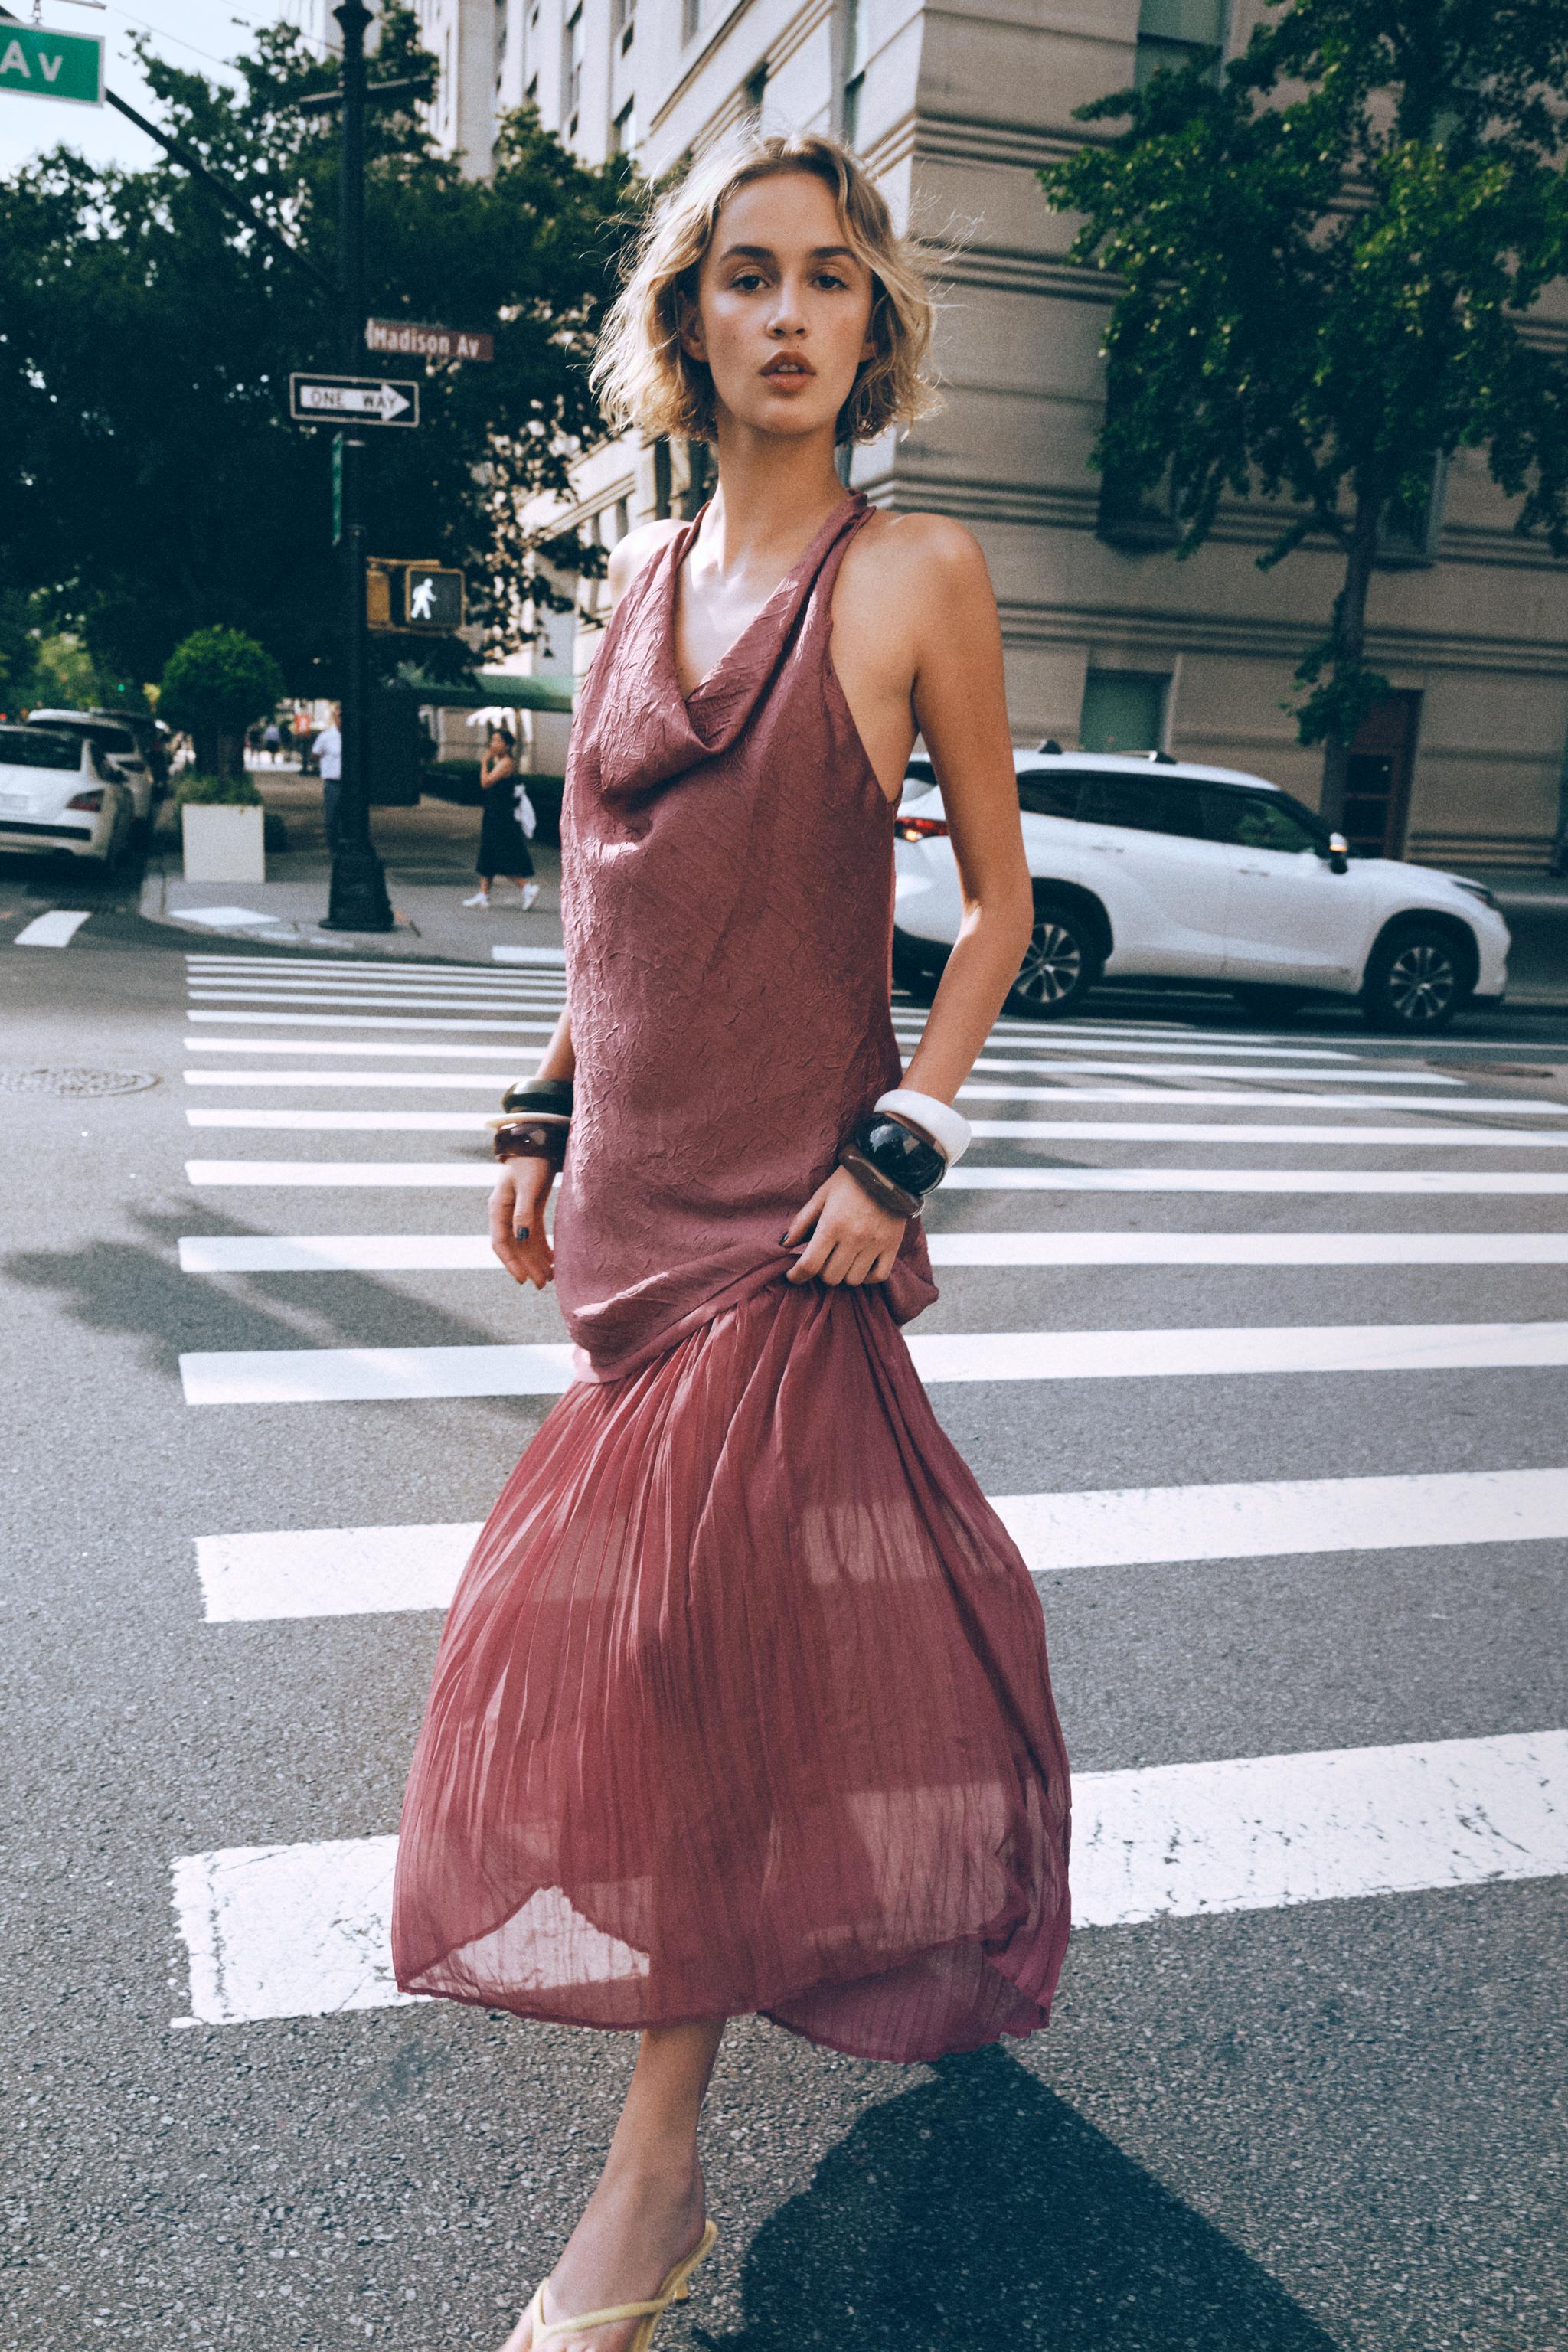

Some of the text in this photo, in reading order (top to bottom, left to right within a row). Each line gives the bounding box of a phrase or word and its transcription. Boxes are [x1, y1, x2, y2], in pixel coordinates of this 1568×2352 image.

[0, 39, 63, 82] Av
[373, 327, 479, 358] Madison Av
[311, 388, 398, 410] ONE WAY
